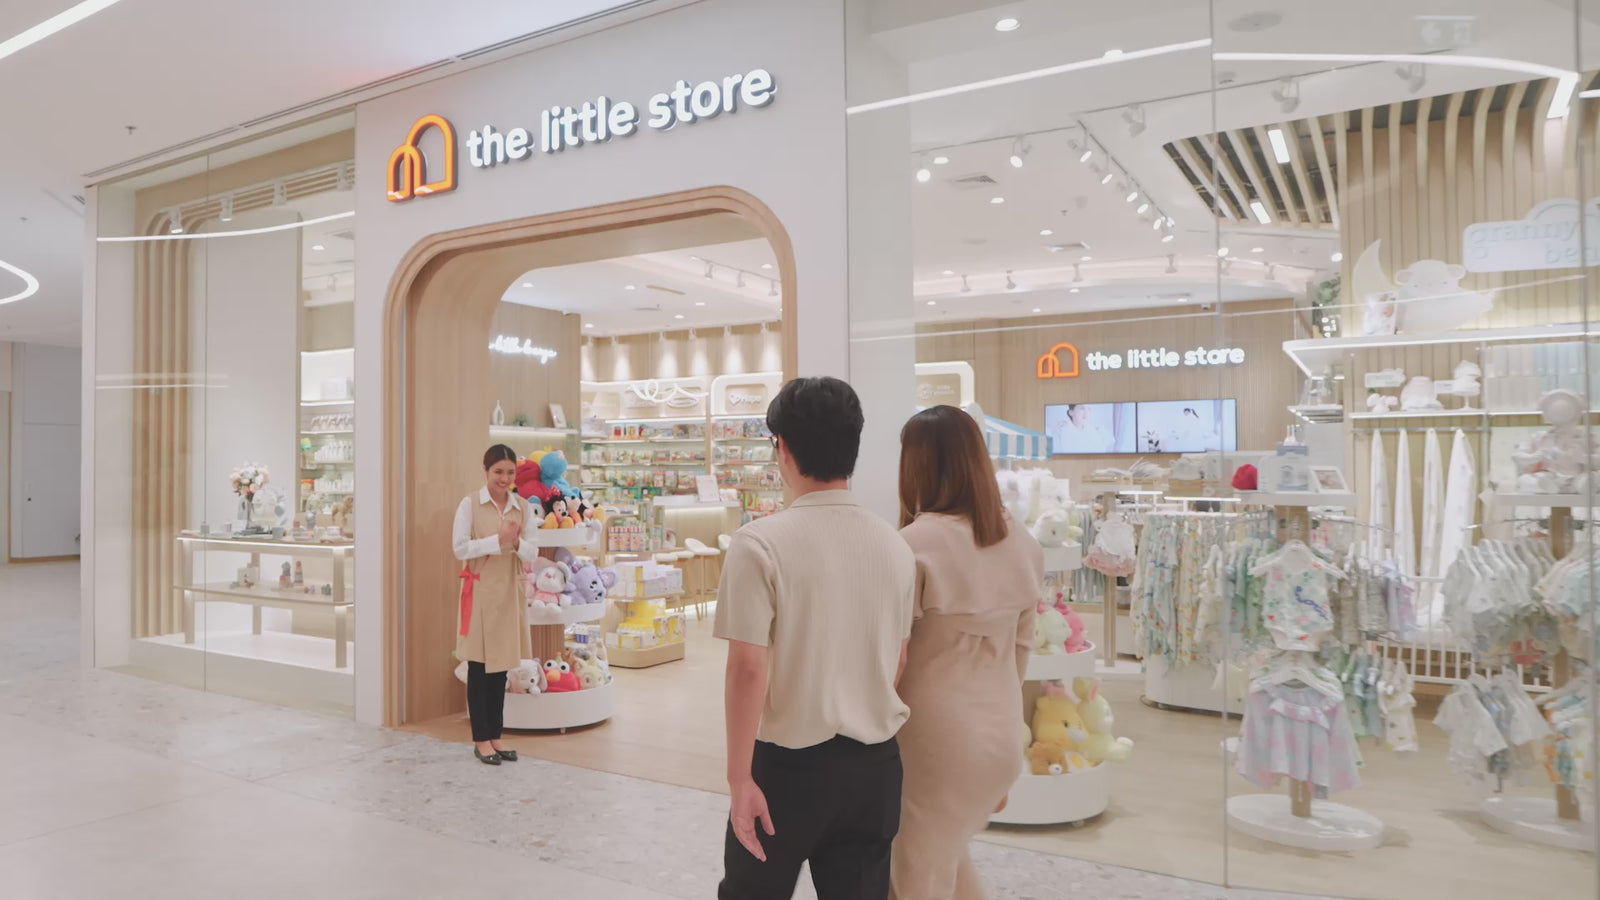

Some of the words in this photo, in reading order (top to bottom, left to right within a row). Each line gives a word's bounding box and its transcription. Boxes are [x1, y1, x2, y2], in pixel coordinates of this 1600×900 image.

[466, 125, 531, 168] the
[541, 96, 637, 153] little
[648, 68, 775, 130] store
[1086, 350, 1122, 370] the
[1128, 347, 1179, 368] little
[1184, 346, 1245, 368] store
